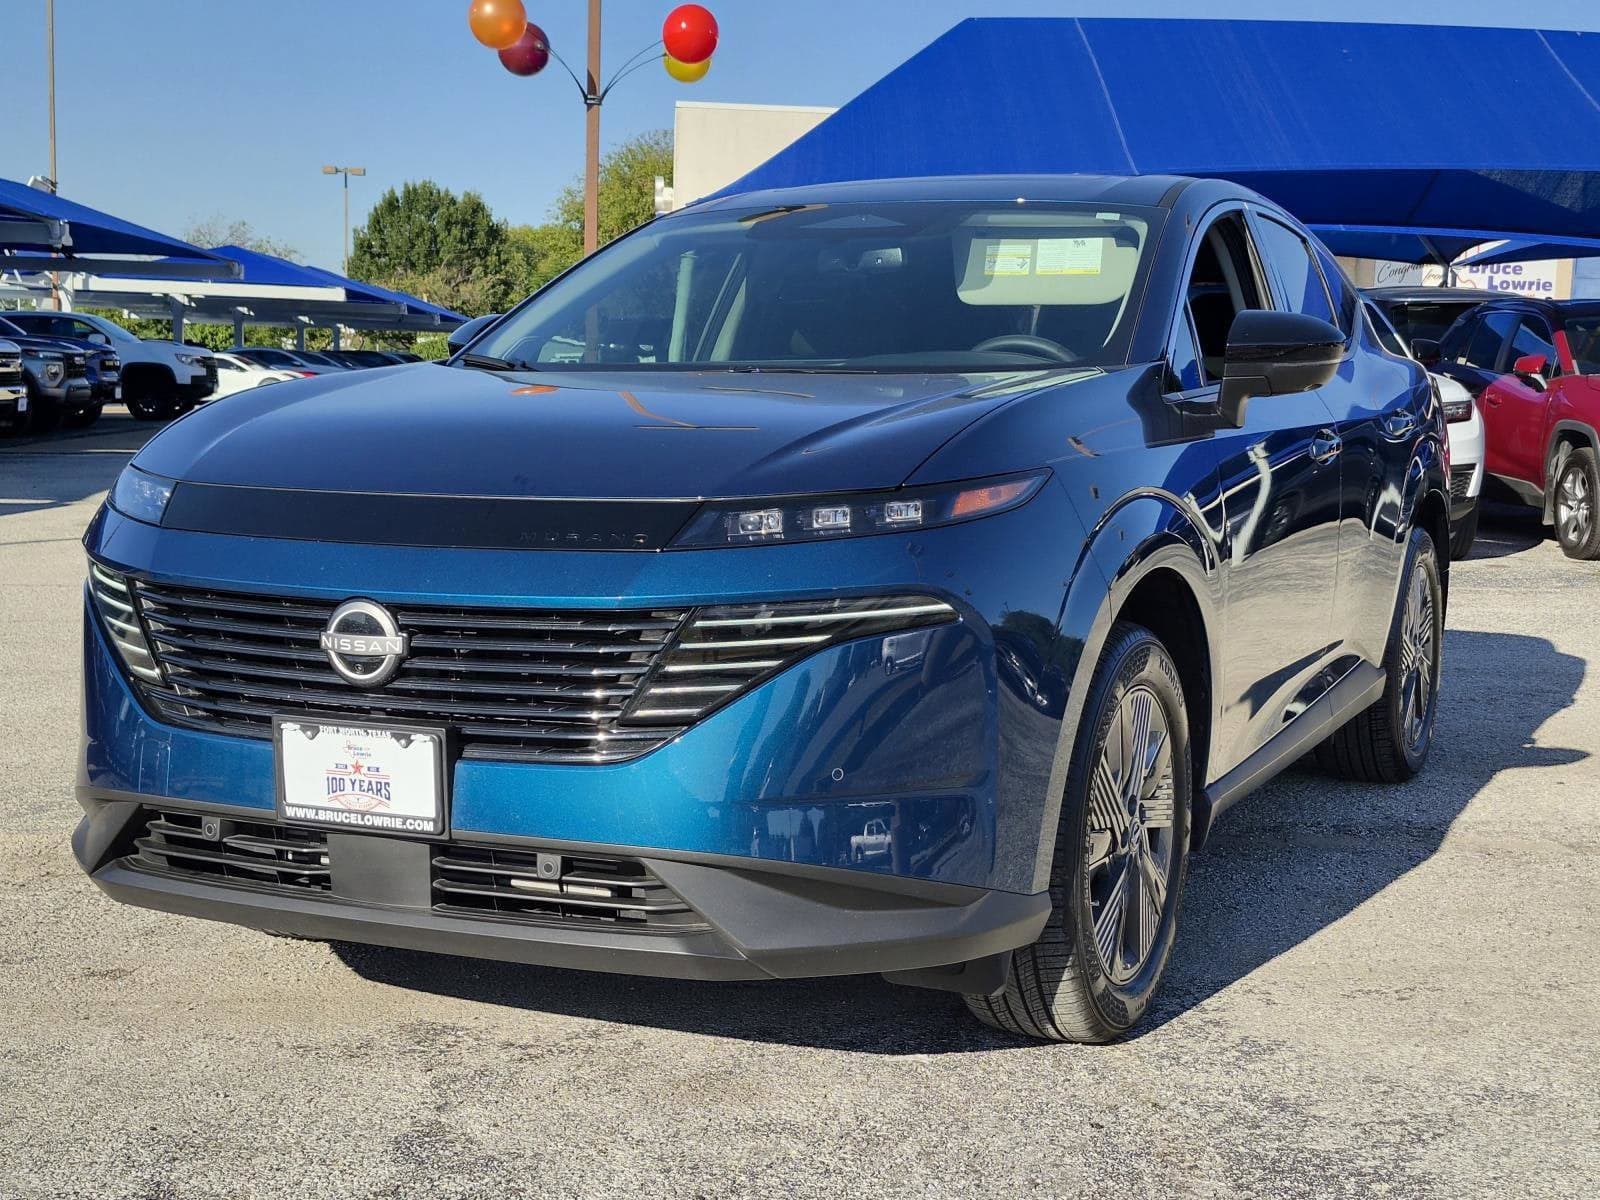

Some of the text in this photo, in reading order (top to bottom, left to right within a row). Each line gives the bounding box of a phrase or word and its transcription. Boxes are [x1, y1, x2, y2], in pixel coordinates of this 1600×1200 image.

[1469, 264, 1523, 275] Bruce
[1488, 276, 1553, 291] Lowrie
[321, 635, 401, 652] NISSAN
[327, 776, 392, 801] 100 YEARS
[285, 805, 434, 831] WWW.BRUCELOWRIE.COM
